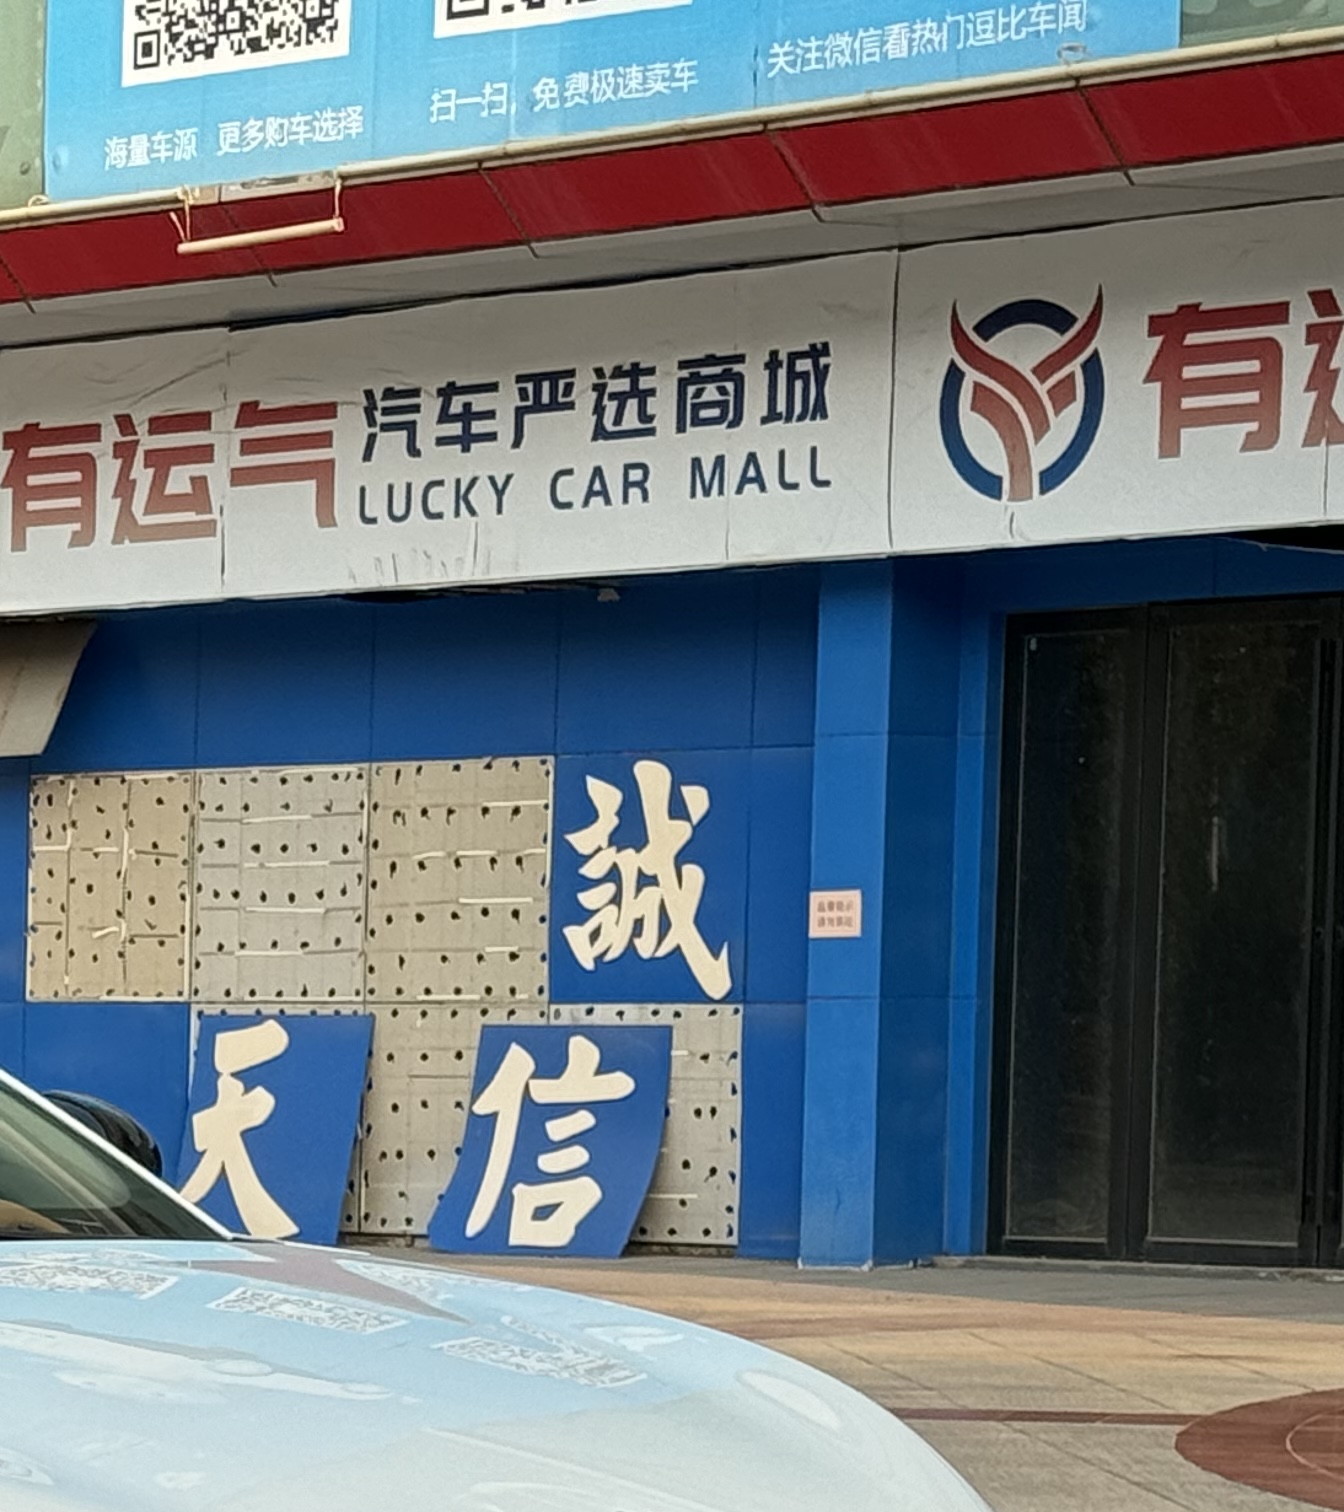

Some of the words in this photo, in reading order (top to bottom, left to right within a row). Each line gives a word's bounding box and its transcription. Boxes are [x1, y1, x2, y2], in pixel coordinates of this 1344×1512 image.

[103, 127, 199, 171] 海量车源
[216, 104, 364, 157] 更多购车选择
[361, 341, 832, 463] 汽车严选商城
[0, 401, 338, 553] 有运气
[359, 472, 513, 525] LUCKY
[549, 462, 650, 511] CAR
[689, 445, 832, 499] MALL
[563, 759, 732, 999] 誠
[466, 1035, 634, 1247] 信
